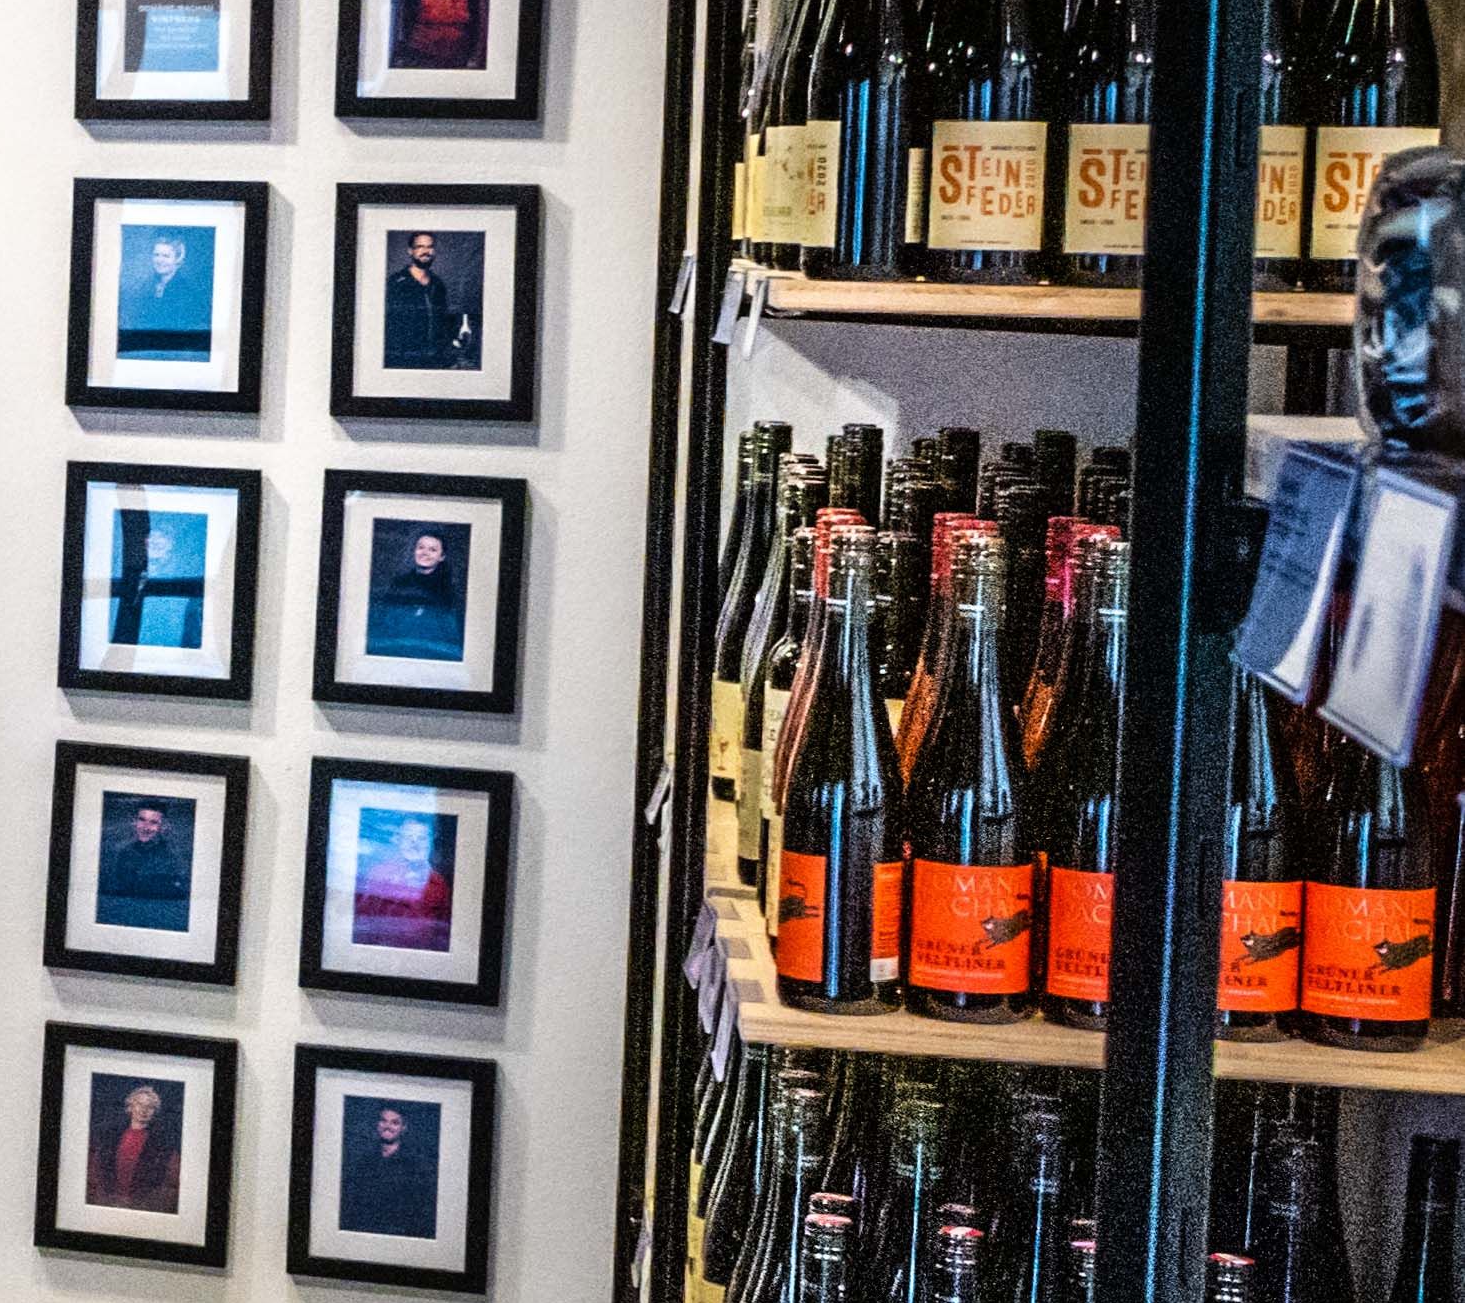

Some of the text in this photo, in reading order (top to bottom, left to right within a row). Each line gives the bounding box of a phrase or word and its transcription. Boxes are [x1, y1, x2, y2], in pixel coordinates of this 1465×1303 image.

[939, 145, 1022, 204] STEIN
[1078, 148, 1146, 209] STEI
[966, 185, 1036, 219] FEDER
[1056, 948, 1108, 964] GRÜNE
[1056, 960, 1104, 977] VELTL
